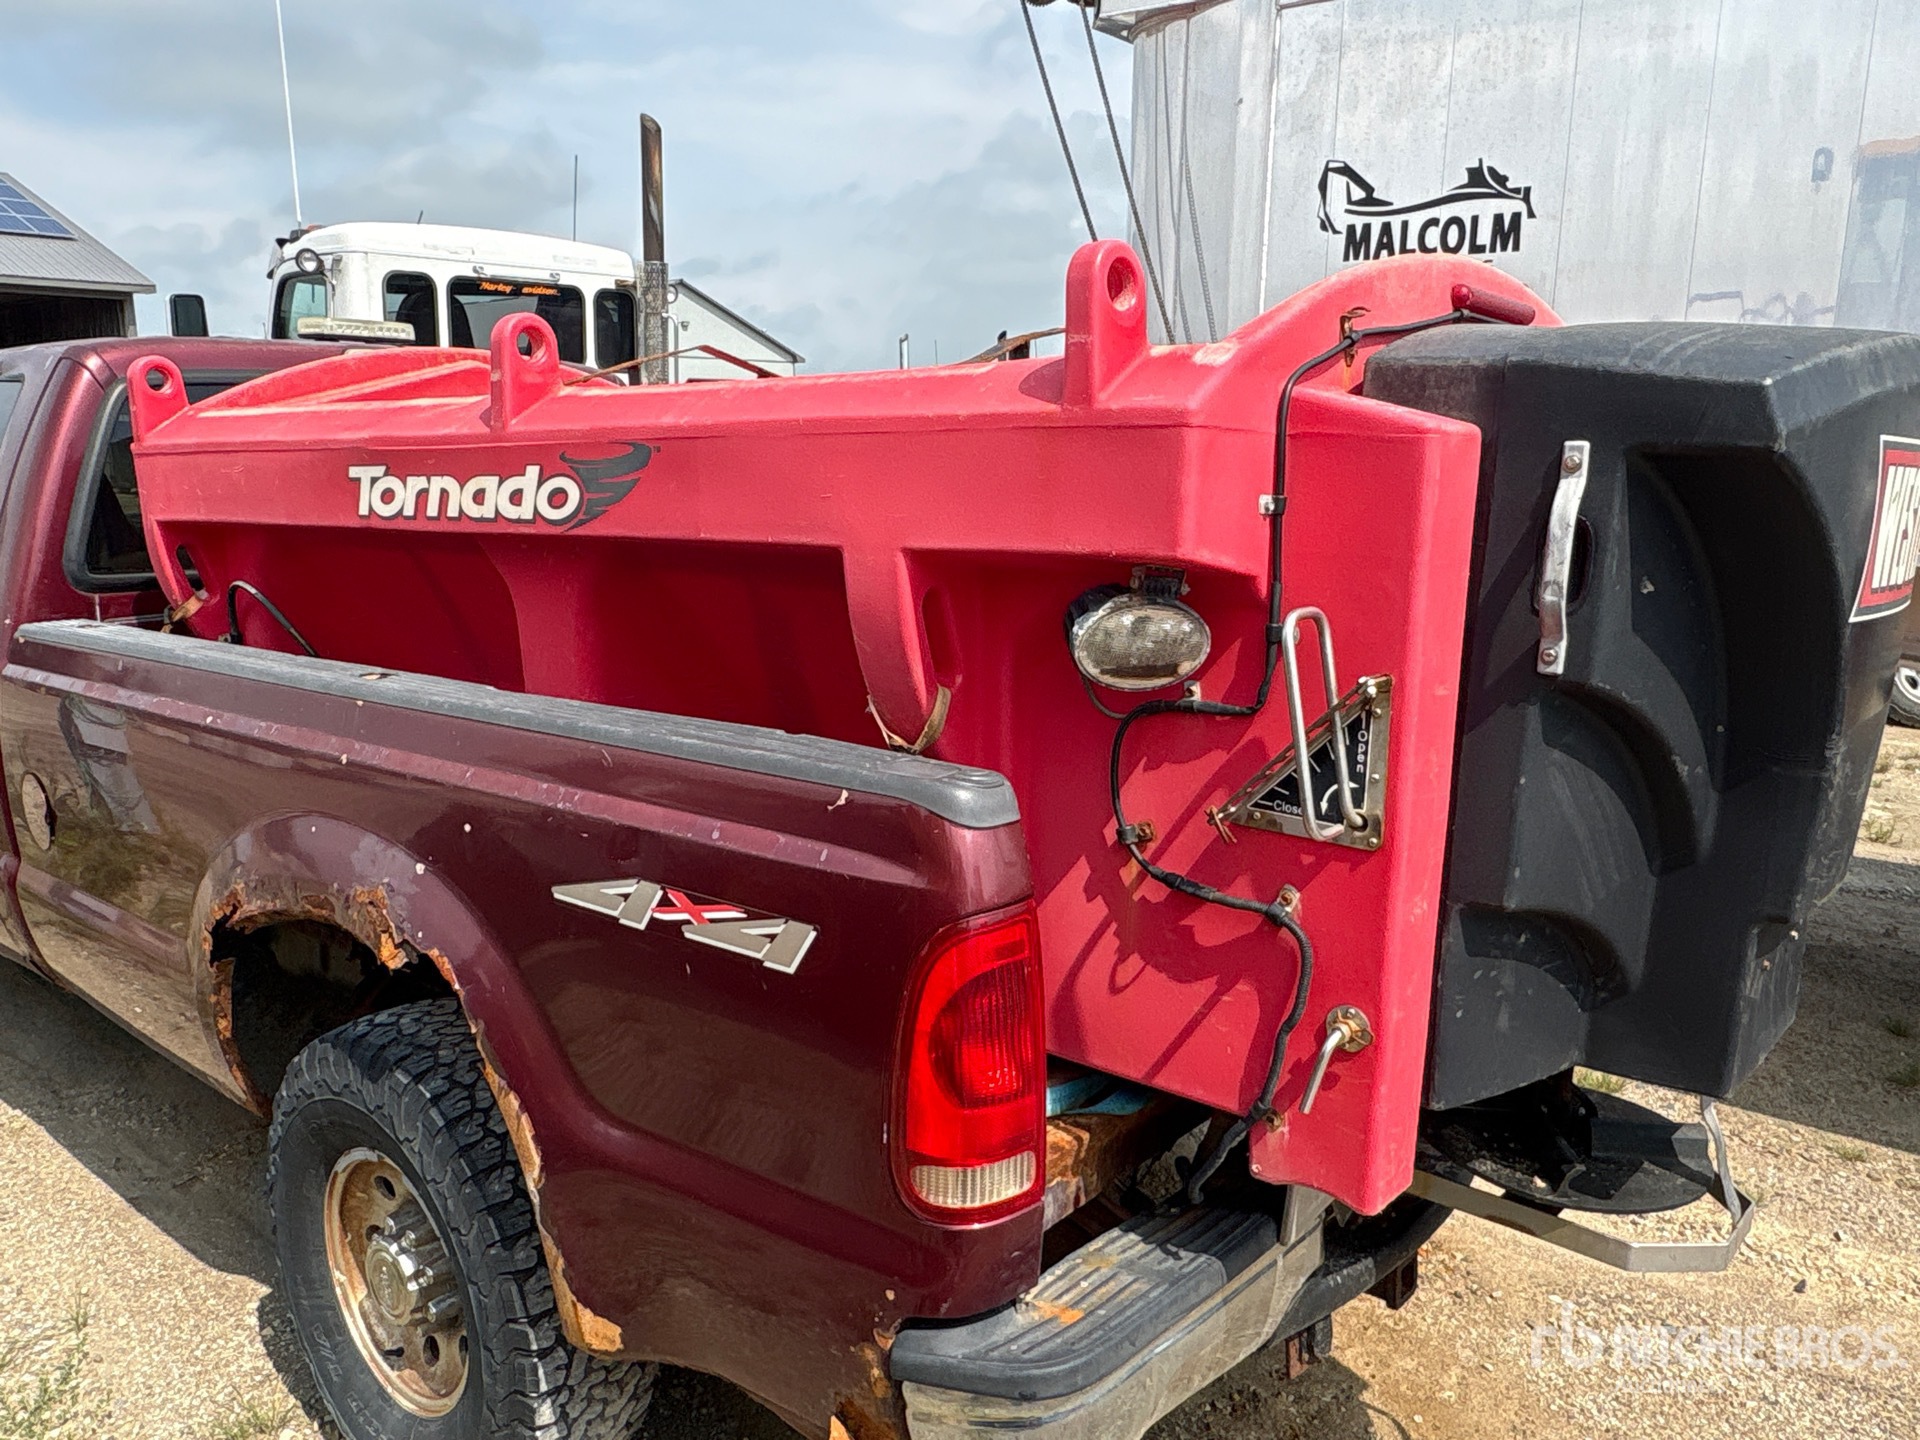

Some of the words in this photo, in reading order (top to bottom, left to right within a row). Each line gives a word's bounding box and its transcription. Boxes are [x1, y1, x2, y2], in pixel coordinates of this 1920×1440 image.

[1343, 211, 1522, 262] MALCOLM
[348, 463, 581, 525] Tornado
[1356, 730, 1368, 773] Open
